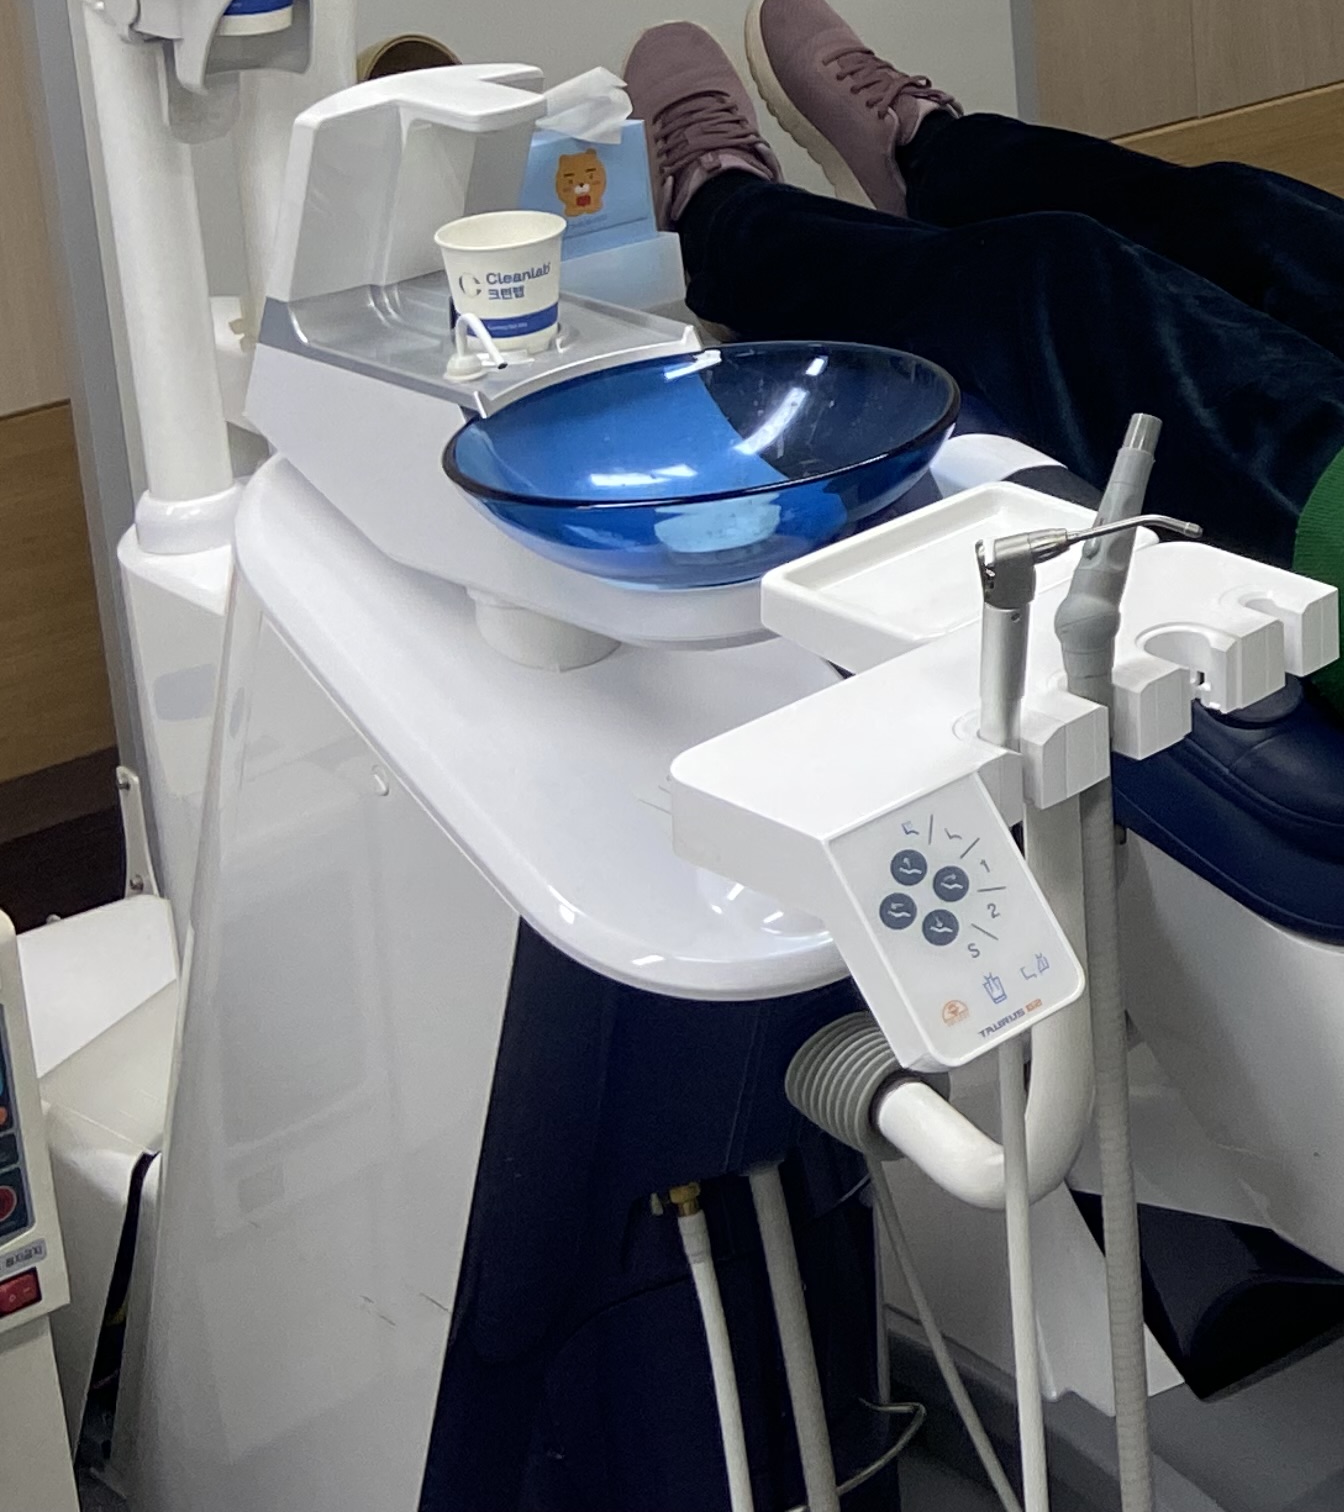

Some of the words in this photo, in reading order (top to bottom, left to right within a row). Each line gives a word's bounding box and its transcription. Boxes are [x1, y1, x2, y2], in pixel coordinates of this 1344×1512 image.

[486, 262, 551, 285] Cleanlab
[979, 859, 991, 873] 1
[986, 902, 1000, 919] 2
[967, 942, 981, 959] S
[977, 1007, 1026, 1038] TAURUS
